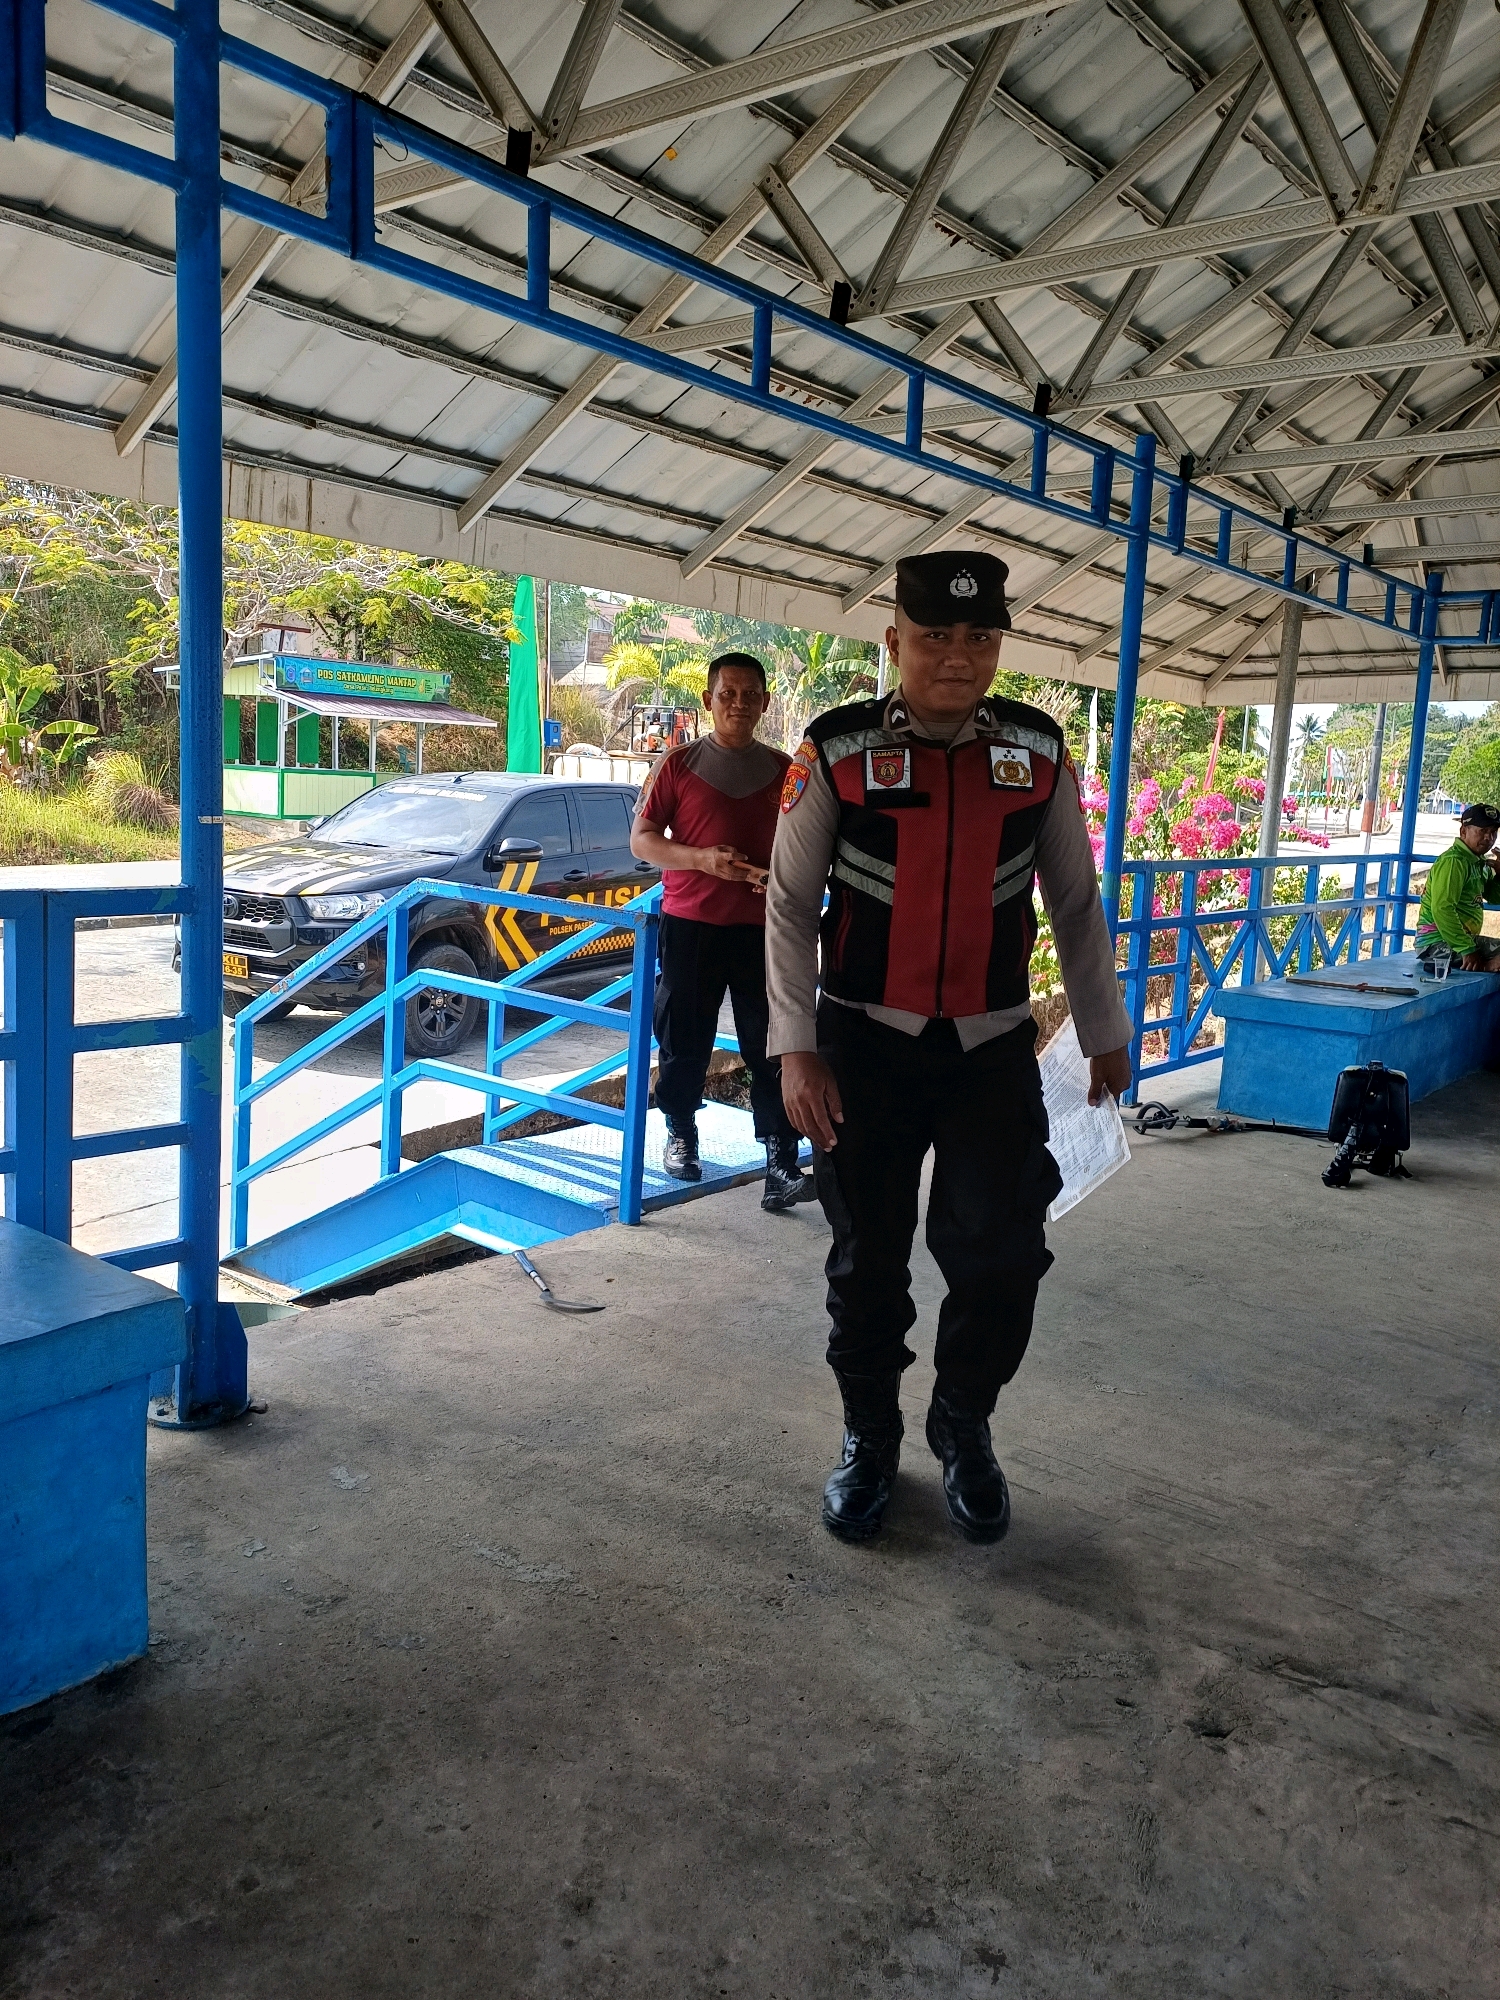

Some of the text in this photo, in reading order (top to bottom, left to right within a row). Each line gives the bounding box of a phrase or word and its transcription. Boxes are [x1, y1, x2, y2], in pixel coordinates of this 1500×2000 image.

[317, 669, 334, 680] POS
[337, 671, 385, 685] SATKAMLING
[387, 676, 417, 688] MANTAP
[872, 750, 904, 758] SAMAPTA
[549, 925, 573, 936] POLSEK
